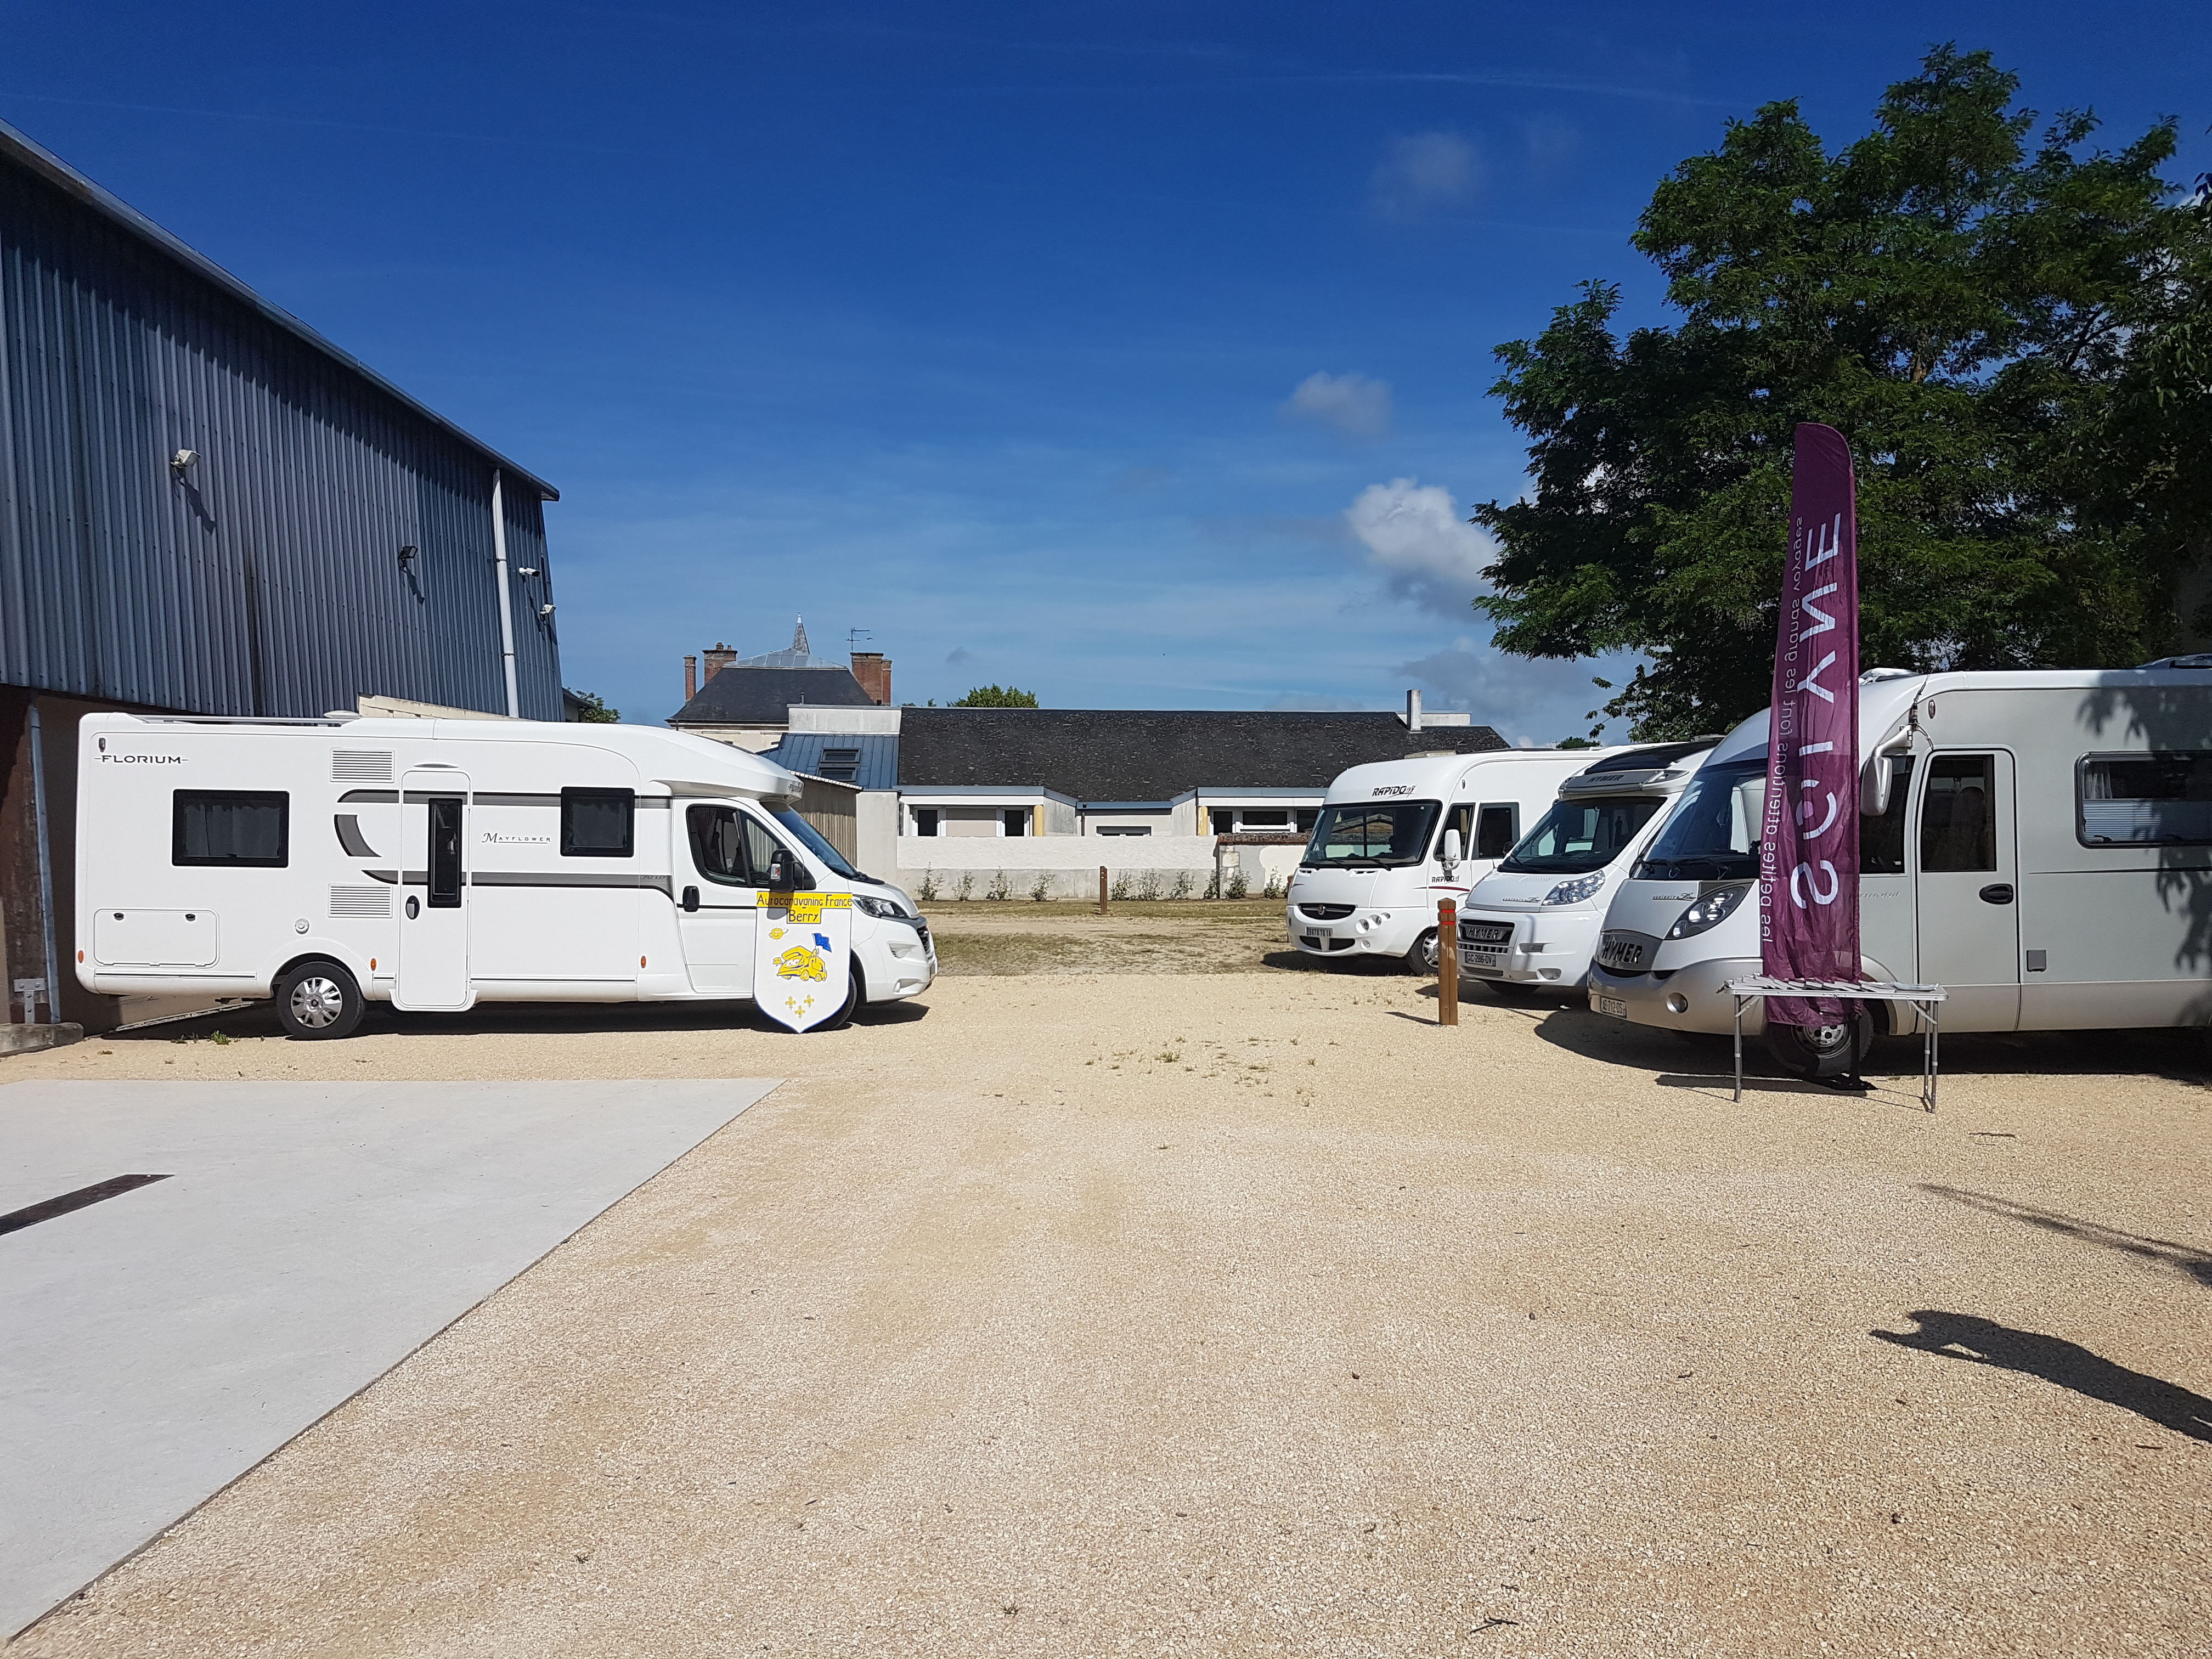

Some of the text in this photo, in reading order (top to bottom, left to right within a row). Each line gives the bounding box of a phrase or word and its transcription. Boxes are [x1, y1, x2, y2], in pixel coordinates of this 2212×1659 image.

[101, 755, 182, 764] FLORIUM
[826, 894, 852, 906] France
[789, 910, 819, 922] Berry
[1601, 940, 1643, 964] HYMER
